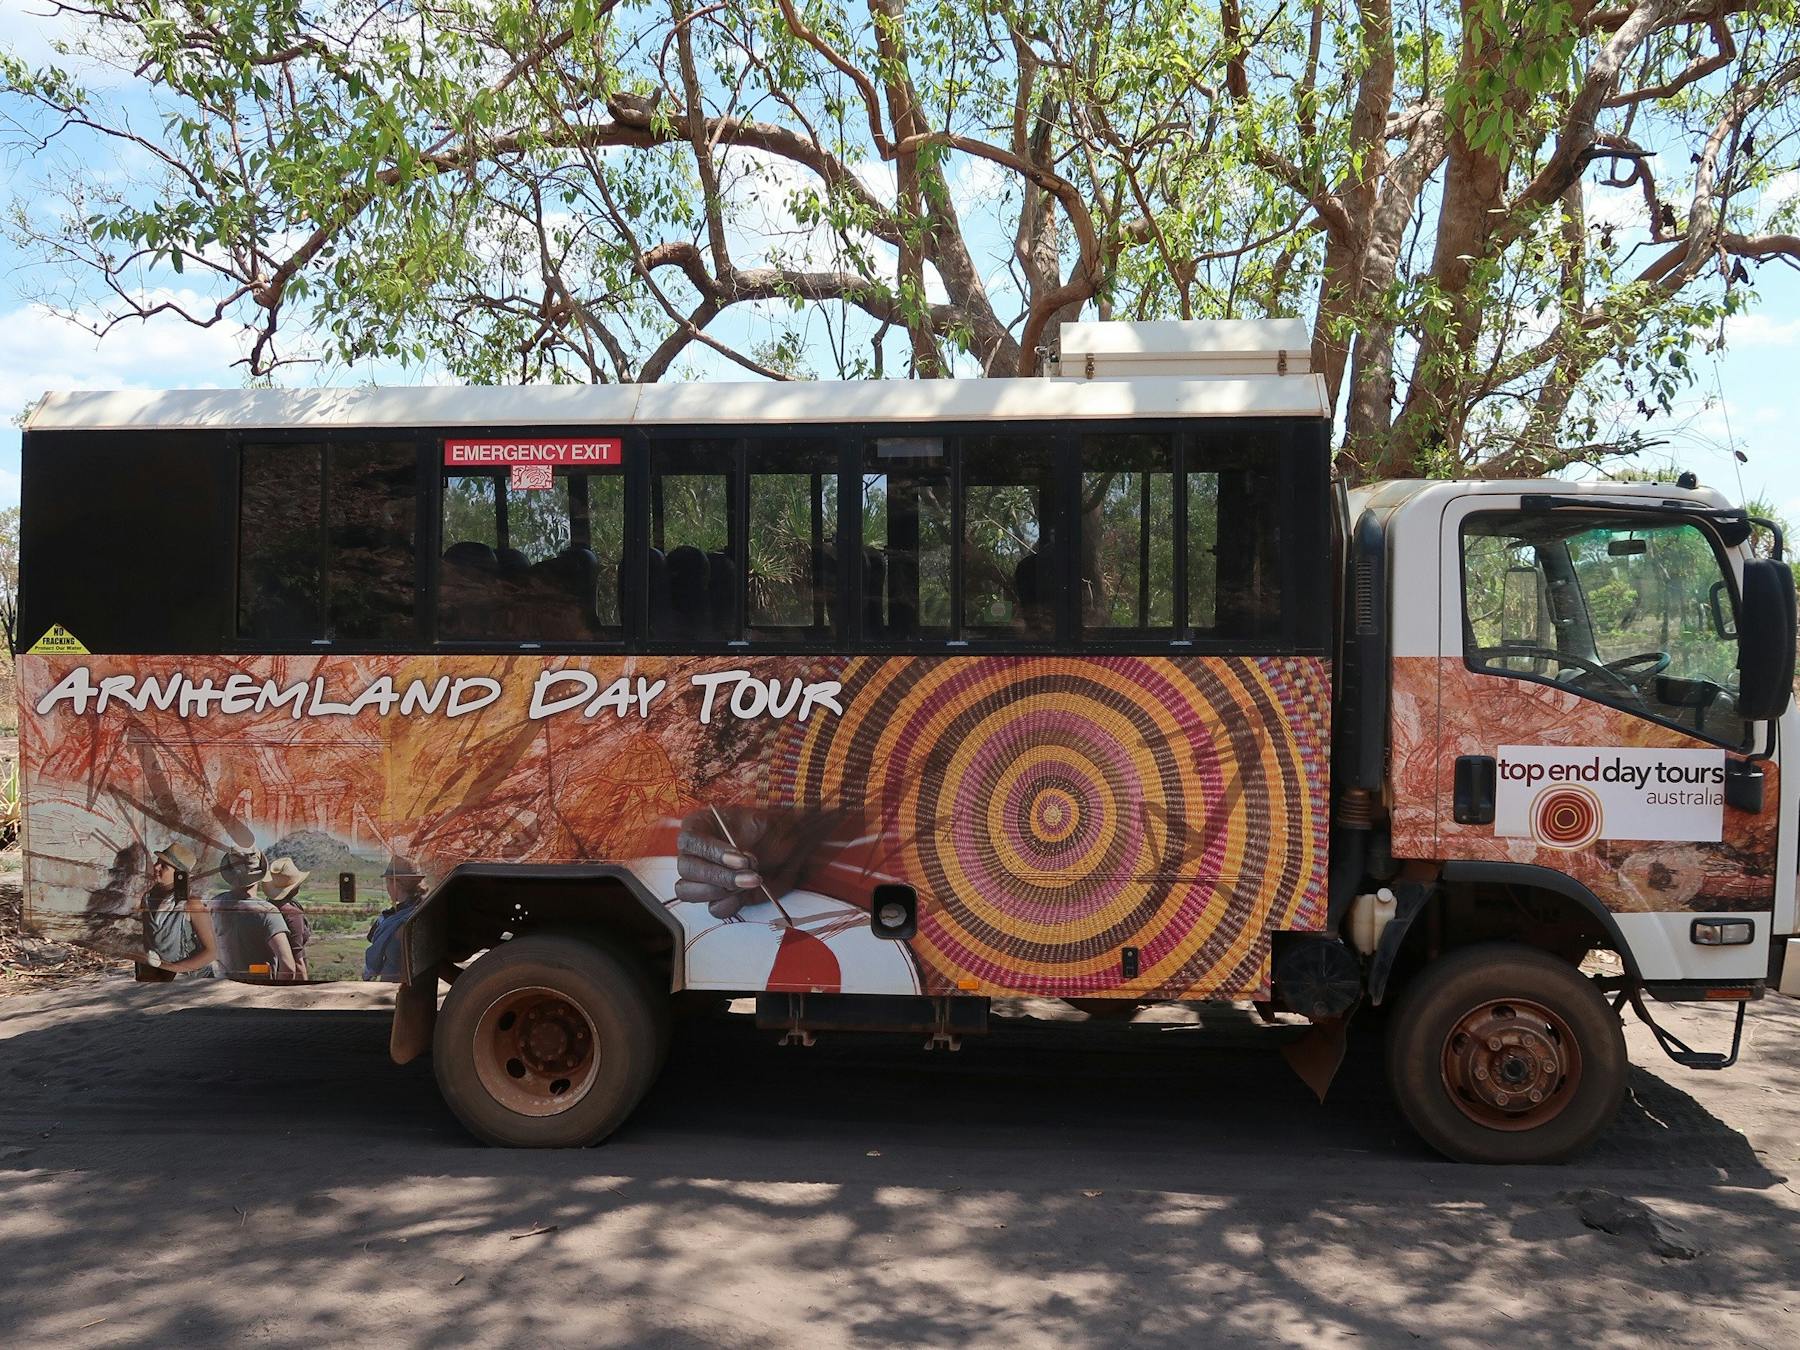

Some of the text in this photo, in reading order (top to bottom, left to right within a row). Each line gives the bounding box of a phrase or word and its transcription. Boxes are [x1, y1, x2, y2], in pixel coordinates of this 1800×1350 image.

[452, 444, 611, 461] EMERGENCY EXIT
[42, 637, 75, 645] FRACKING
[53, 628, 64, 636] NO
[36, 667, 843, 723] ARNHEMLAND DAY TOUR
[1498, 756, 1724, 790] top end day tours
[1646, 787, 1724, 806] australia
